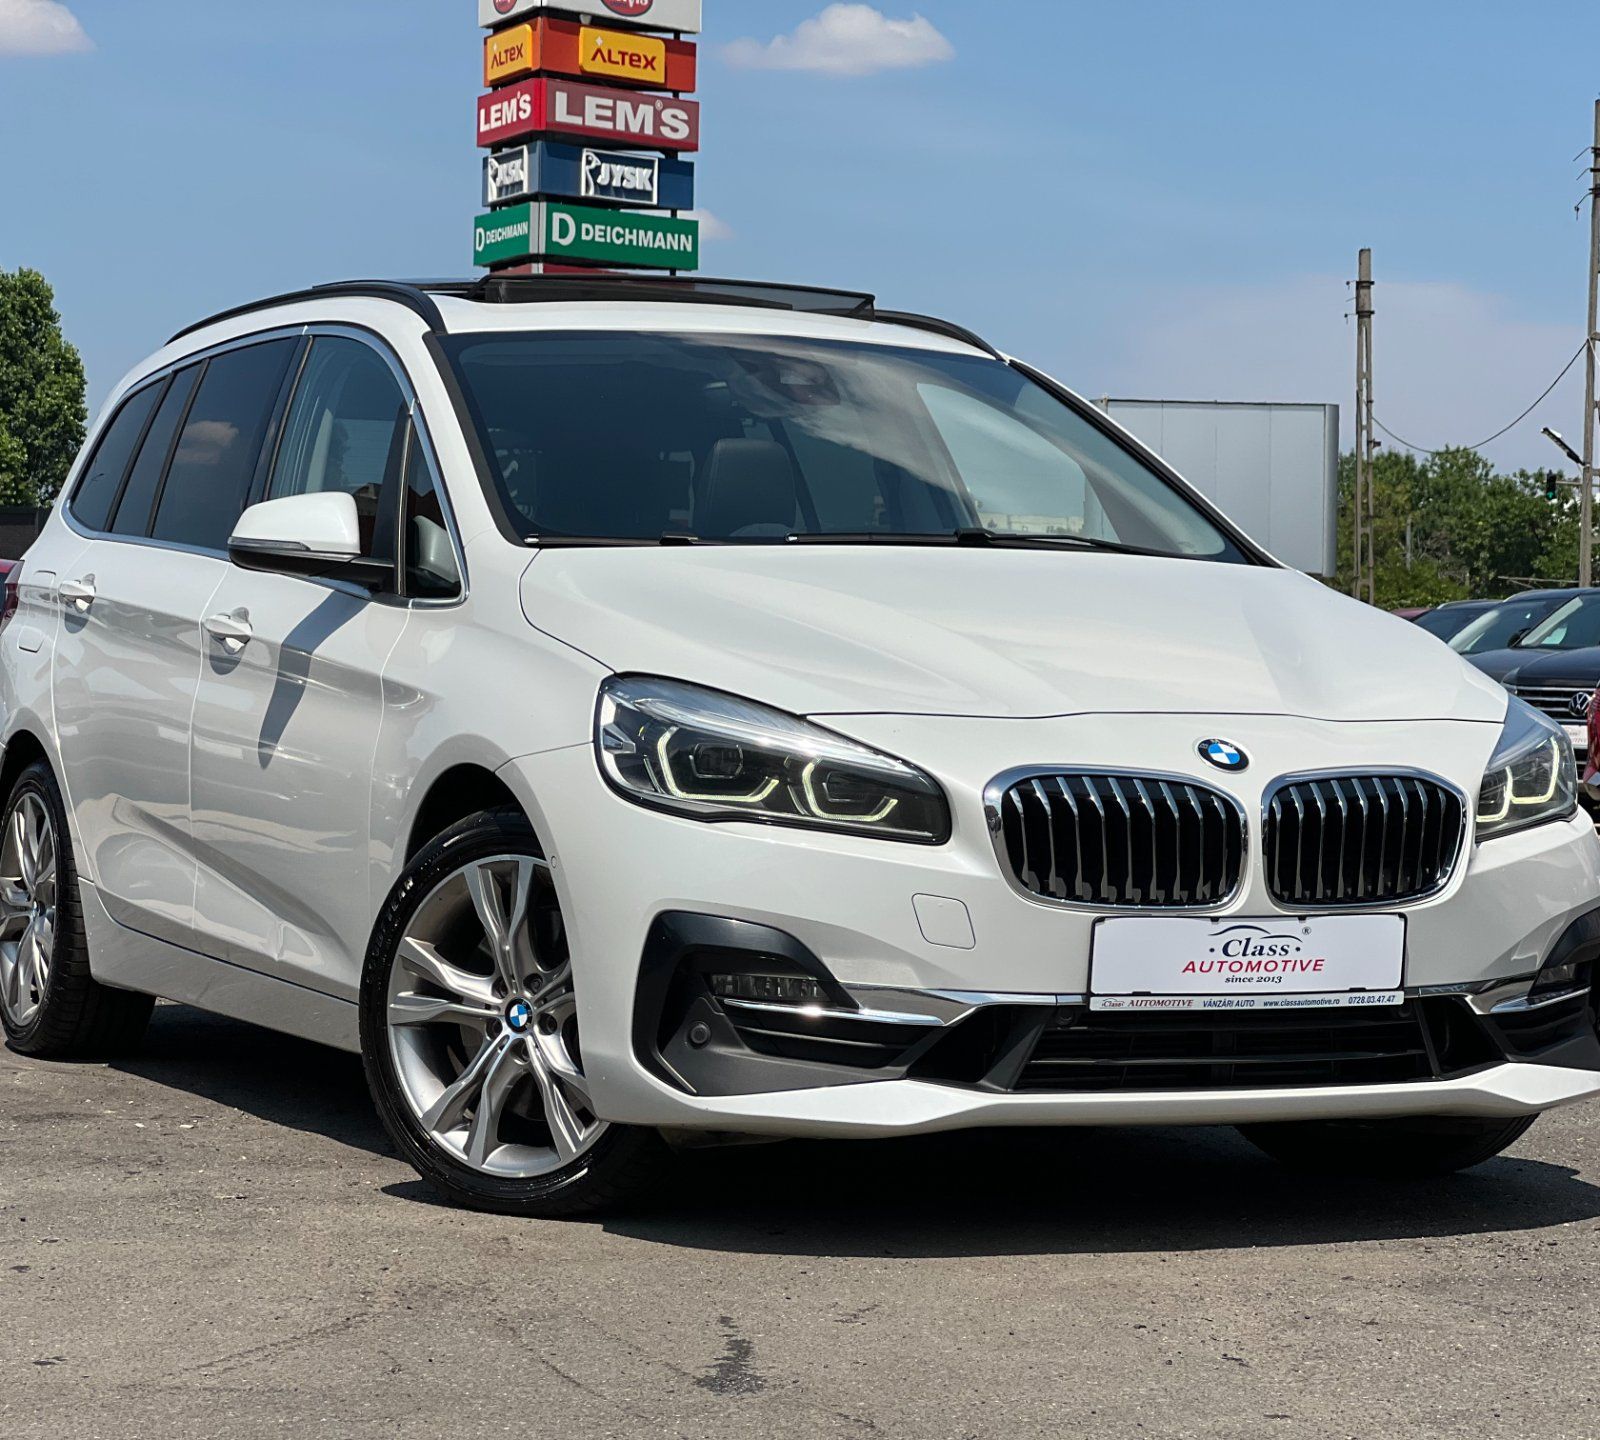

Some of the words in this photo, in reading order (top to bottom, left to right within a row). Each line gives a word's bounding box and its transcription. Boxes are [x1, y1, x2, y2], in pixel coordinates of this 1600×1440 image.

[480, 91, 531, 133] LEM'S
[597, 163, 653, 191] JYSK
[486, 221, 528, 244] DEICHMANN
[581, 223, 692, 252] DEICHMANN
[1222, 937, 1290, 957] Class
[1182, 959, 1325, 973] AUTOMOTIVE
[1225, 975, 1254, 983] since
[1256, 975, 1283, 984] 2013
[1263, 998, 1340, 1007] www.classautomotive.ro
